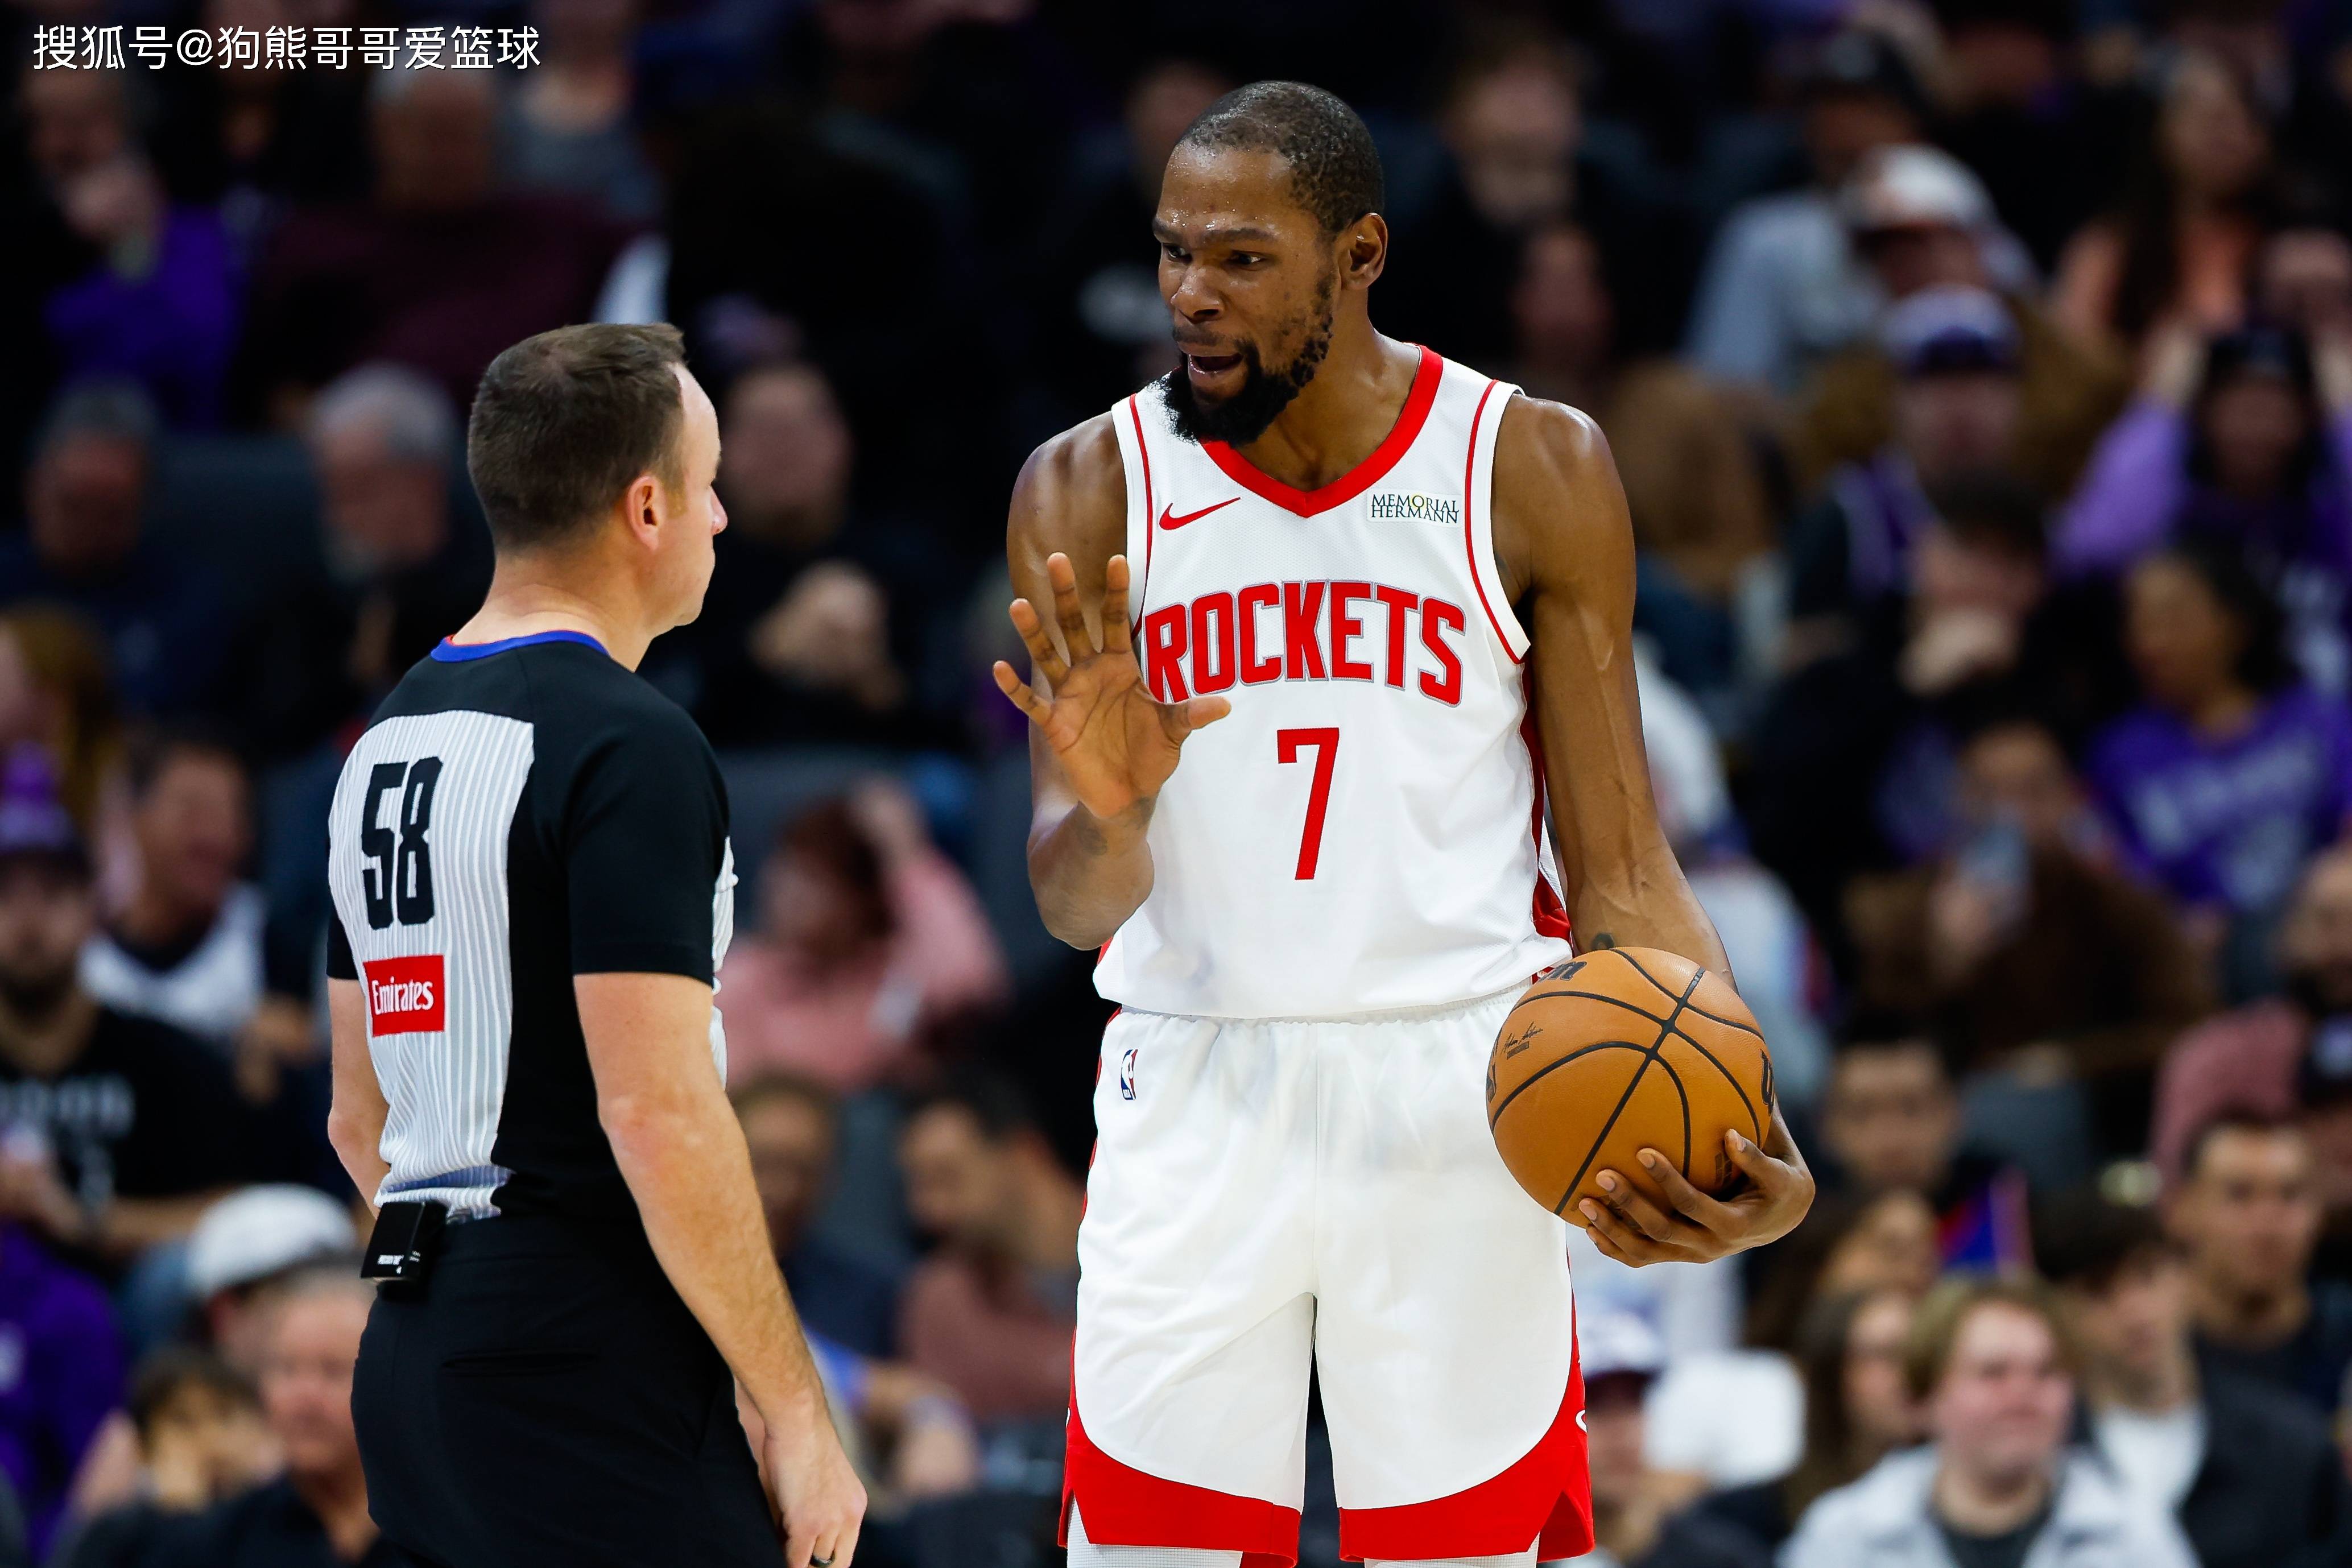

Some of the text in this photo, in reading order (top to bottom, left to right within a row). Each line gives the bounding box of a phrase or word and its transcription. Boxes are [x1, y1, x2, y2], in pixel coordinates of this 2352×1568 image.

[1371, 504, 1458, 524] HERMANN
[1372, 494, 1460, 513] MEMORIAL
[1144, 580, 1466, 707] ROCKETS
[361, 756, 443, 930] 58
[1277, 727, 1340, 880] 7
[371, 976, 434, 1015] Emirates
